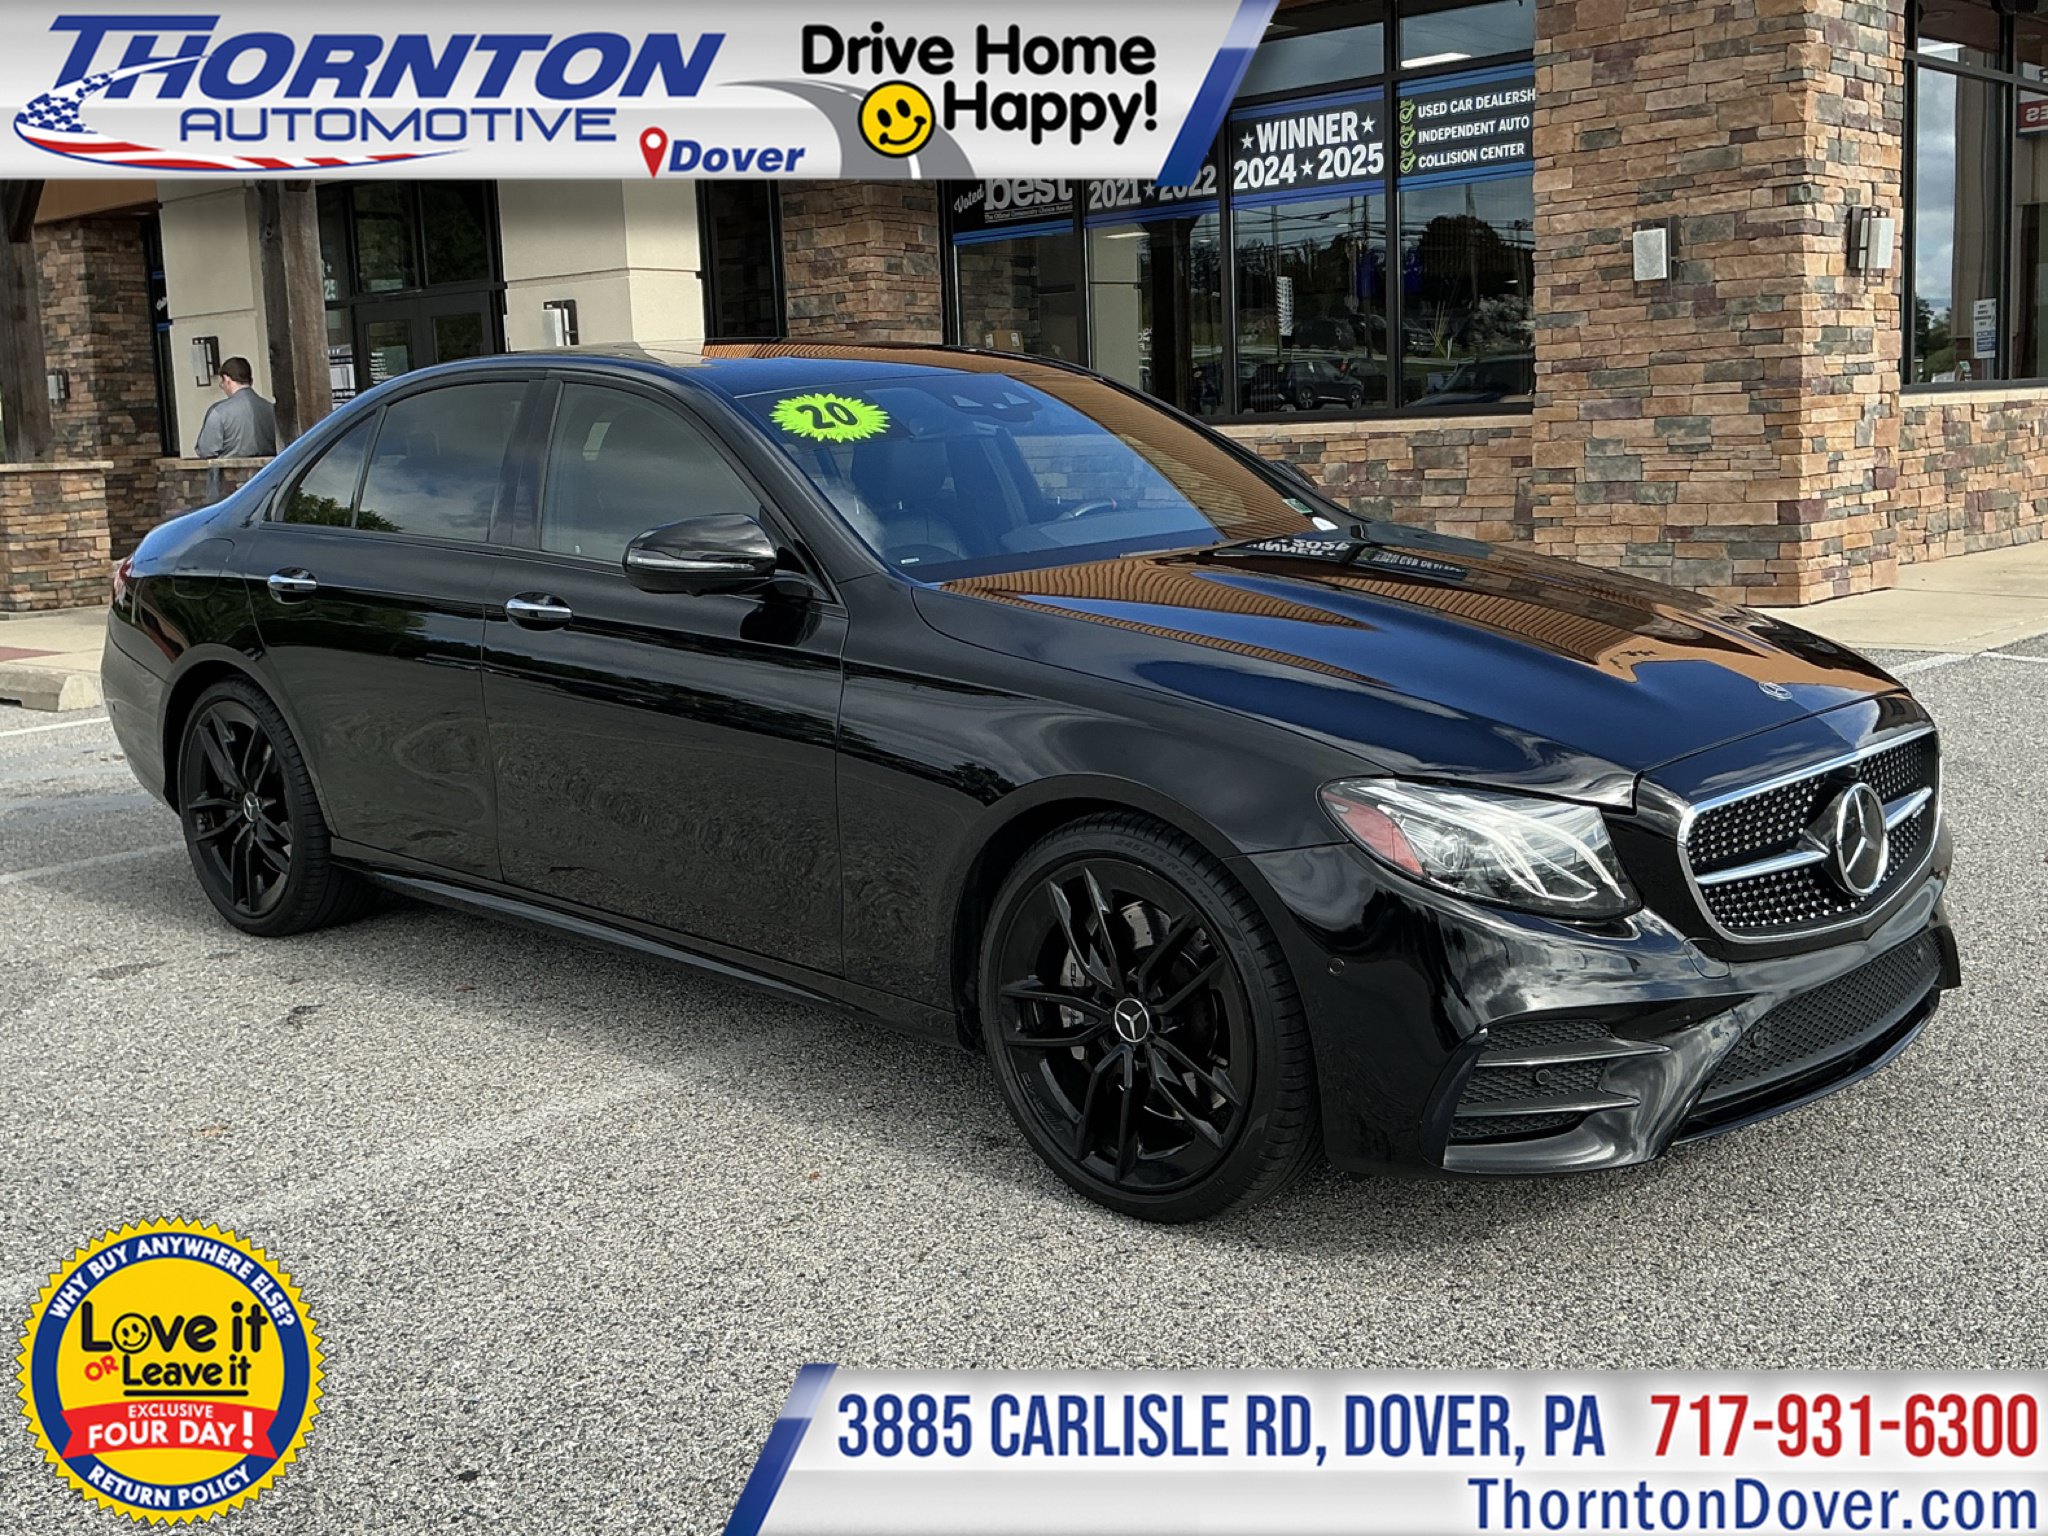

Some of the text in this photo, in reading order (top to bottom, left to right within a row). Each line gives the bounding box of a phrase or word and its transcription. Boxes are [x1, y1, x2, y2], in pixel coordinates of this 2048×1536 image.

[1418, 88, 1536, 118] USED CAR DEALERSH
[1256, 111, 1358, 154] WINNER
[1418, 115, 1530, 144] INDEPENDENT AUTO
[1233, 142, 1385, 190] 2024 2025
[1418, 143, 1525, 168] COLLISION CENTER
[953, 183, 985, 213] Voted
[984, 178, 1073, 210] best
[1089, 179, 1142, 210] 2021
[795, 401, 858, 430] 20
